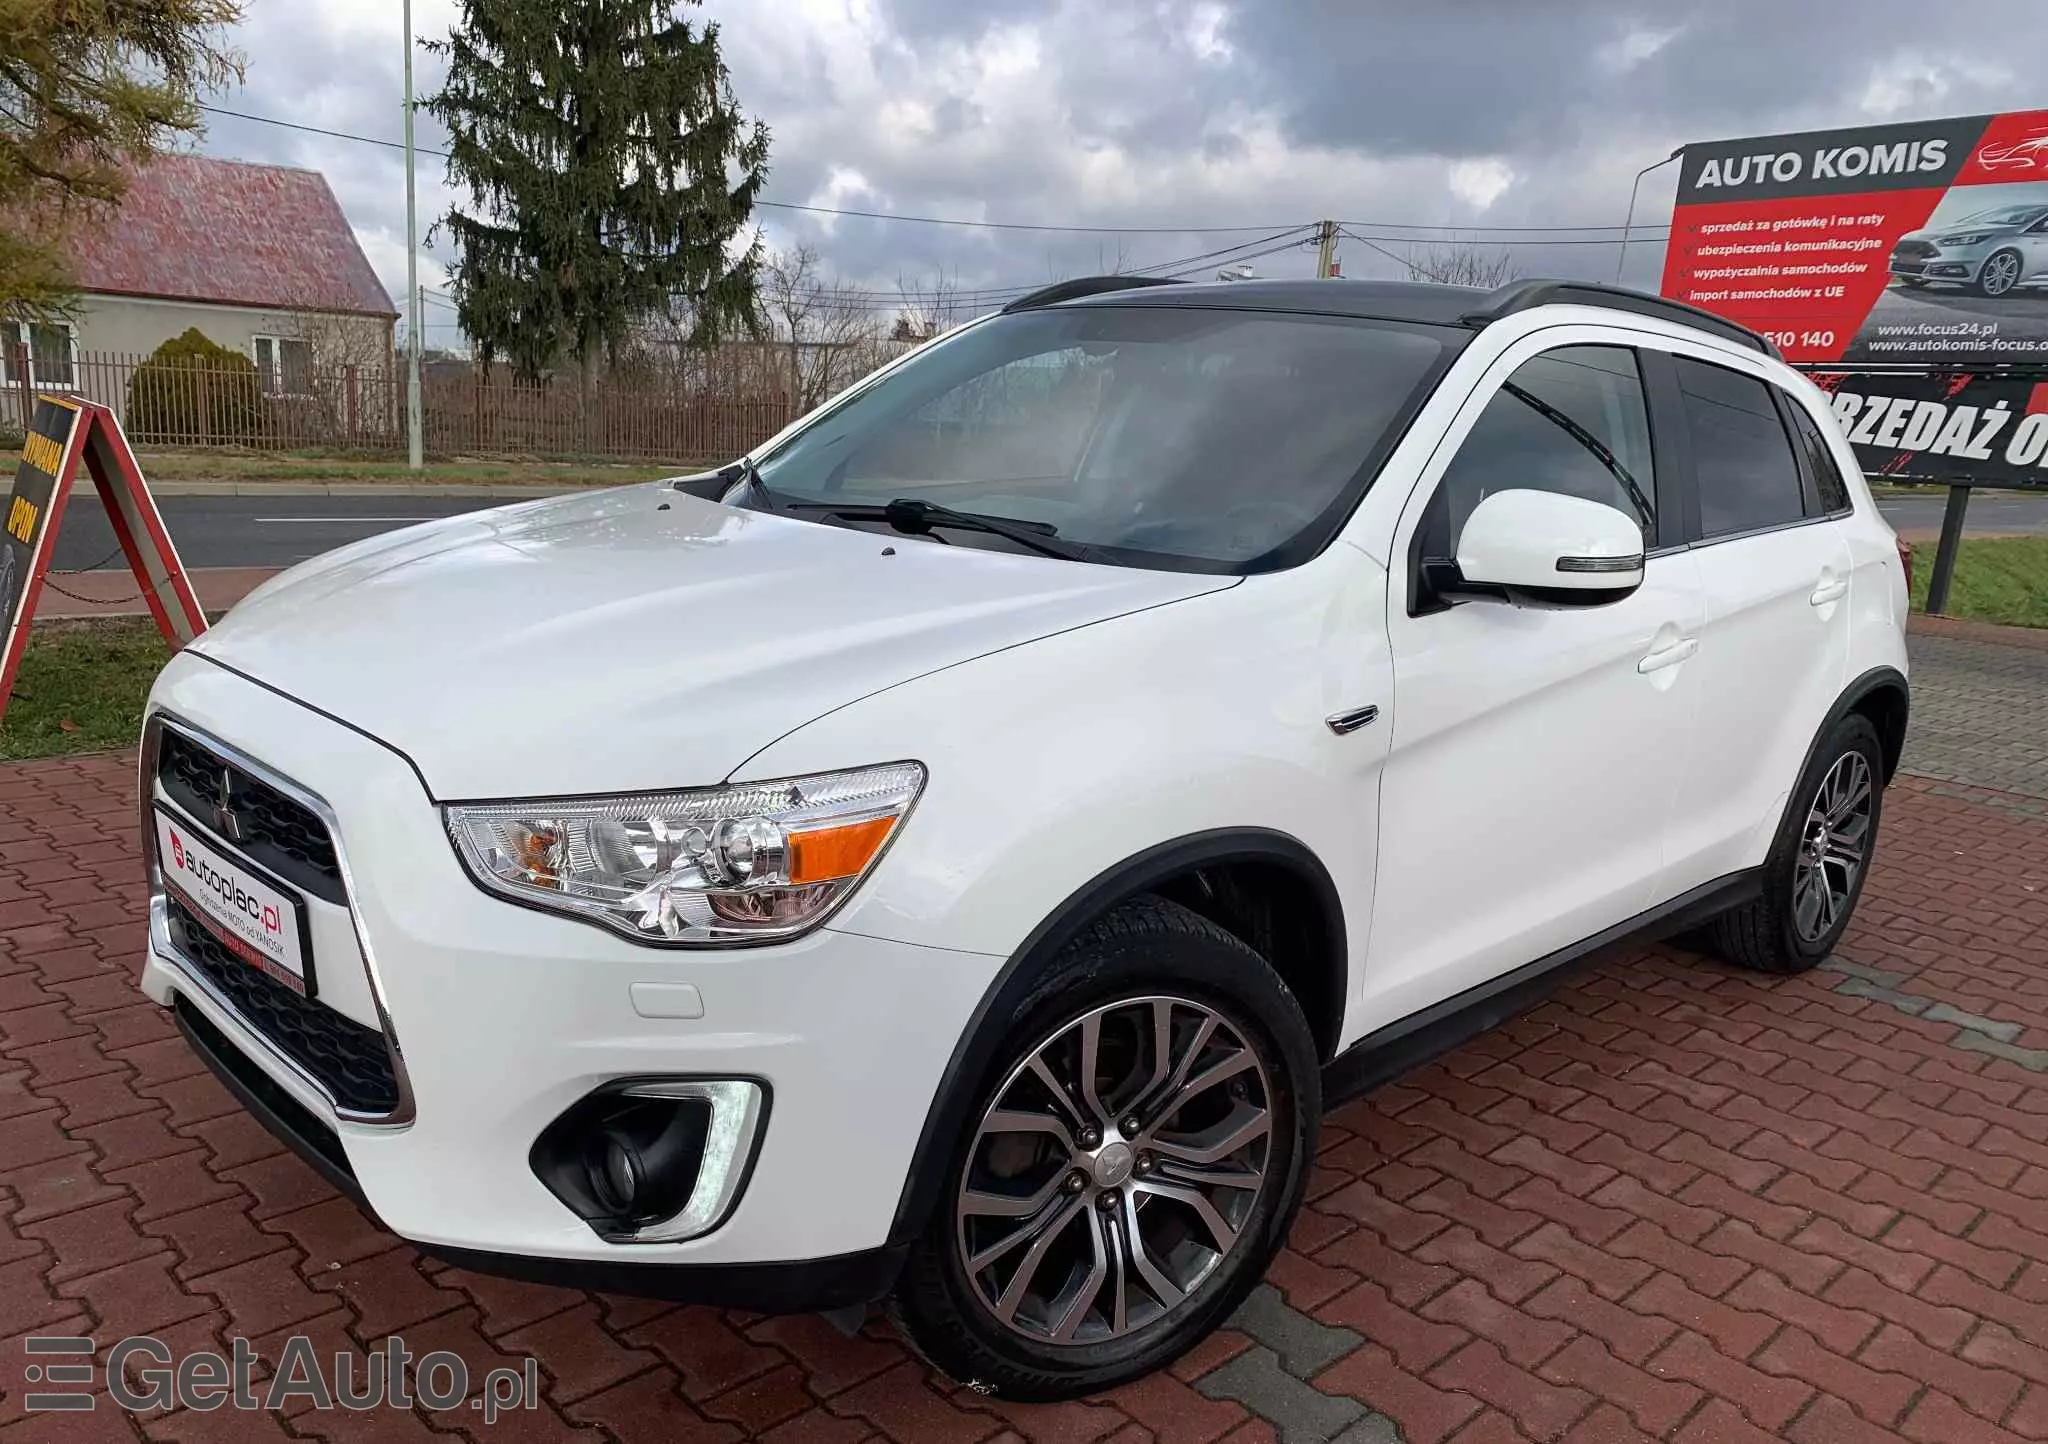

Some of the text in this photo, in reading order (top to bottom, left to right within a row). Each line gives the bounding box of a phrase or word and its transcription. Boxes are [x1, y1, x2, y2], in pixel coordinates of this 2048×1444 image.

[1695, 138, 1949, 189] AUTO KOMIS
[1700, 213, 1886, 235] sprzedaż za gotówkę i na raty
[1696, 237, 1884, 257] ubezpieczenia komunikacyjne
[1693, 262, 1869, 280] wypożyczalnia samochodów
[1689, 285, 1846, 302] import samochodów z UE
[1800, 330, 1835, 347] 140
[1877, 322, 1999, 338] www.focus24.pl
[1824, 390, 2048, 469] RZEDAŻ O
[7, 495, 39, 544] OPON
[185, 849, 282, 936] autoplac.pl
